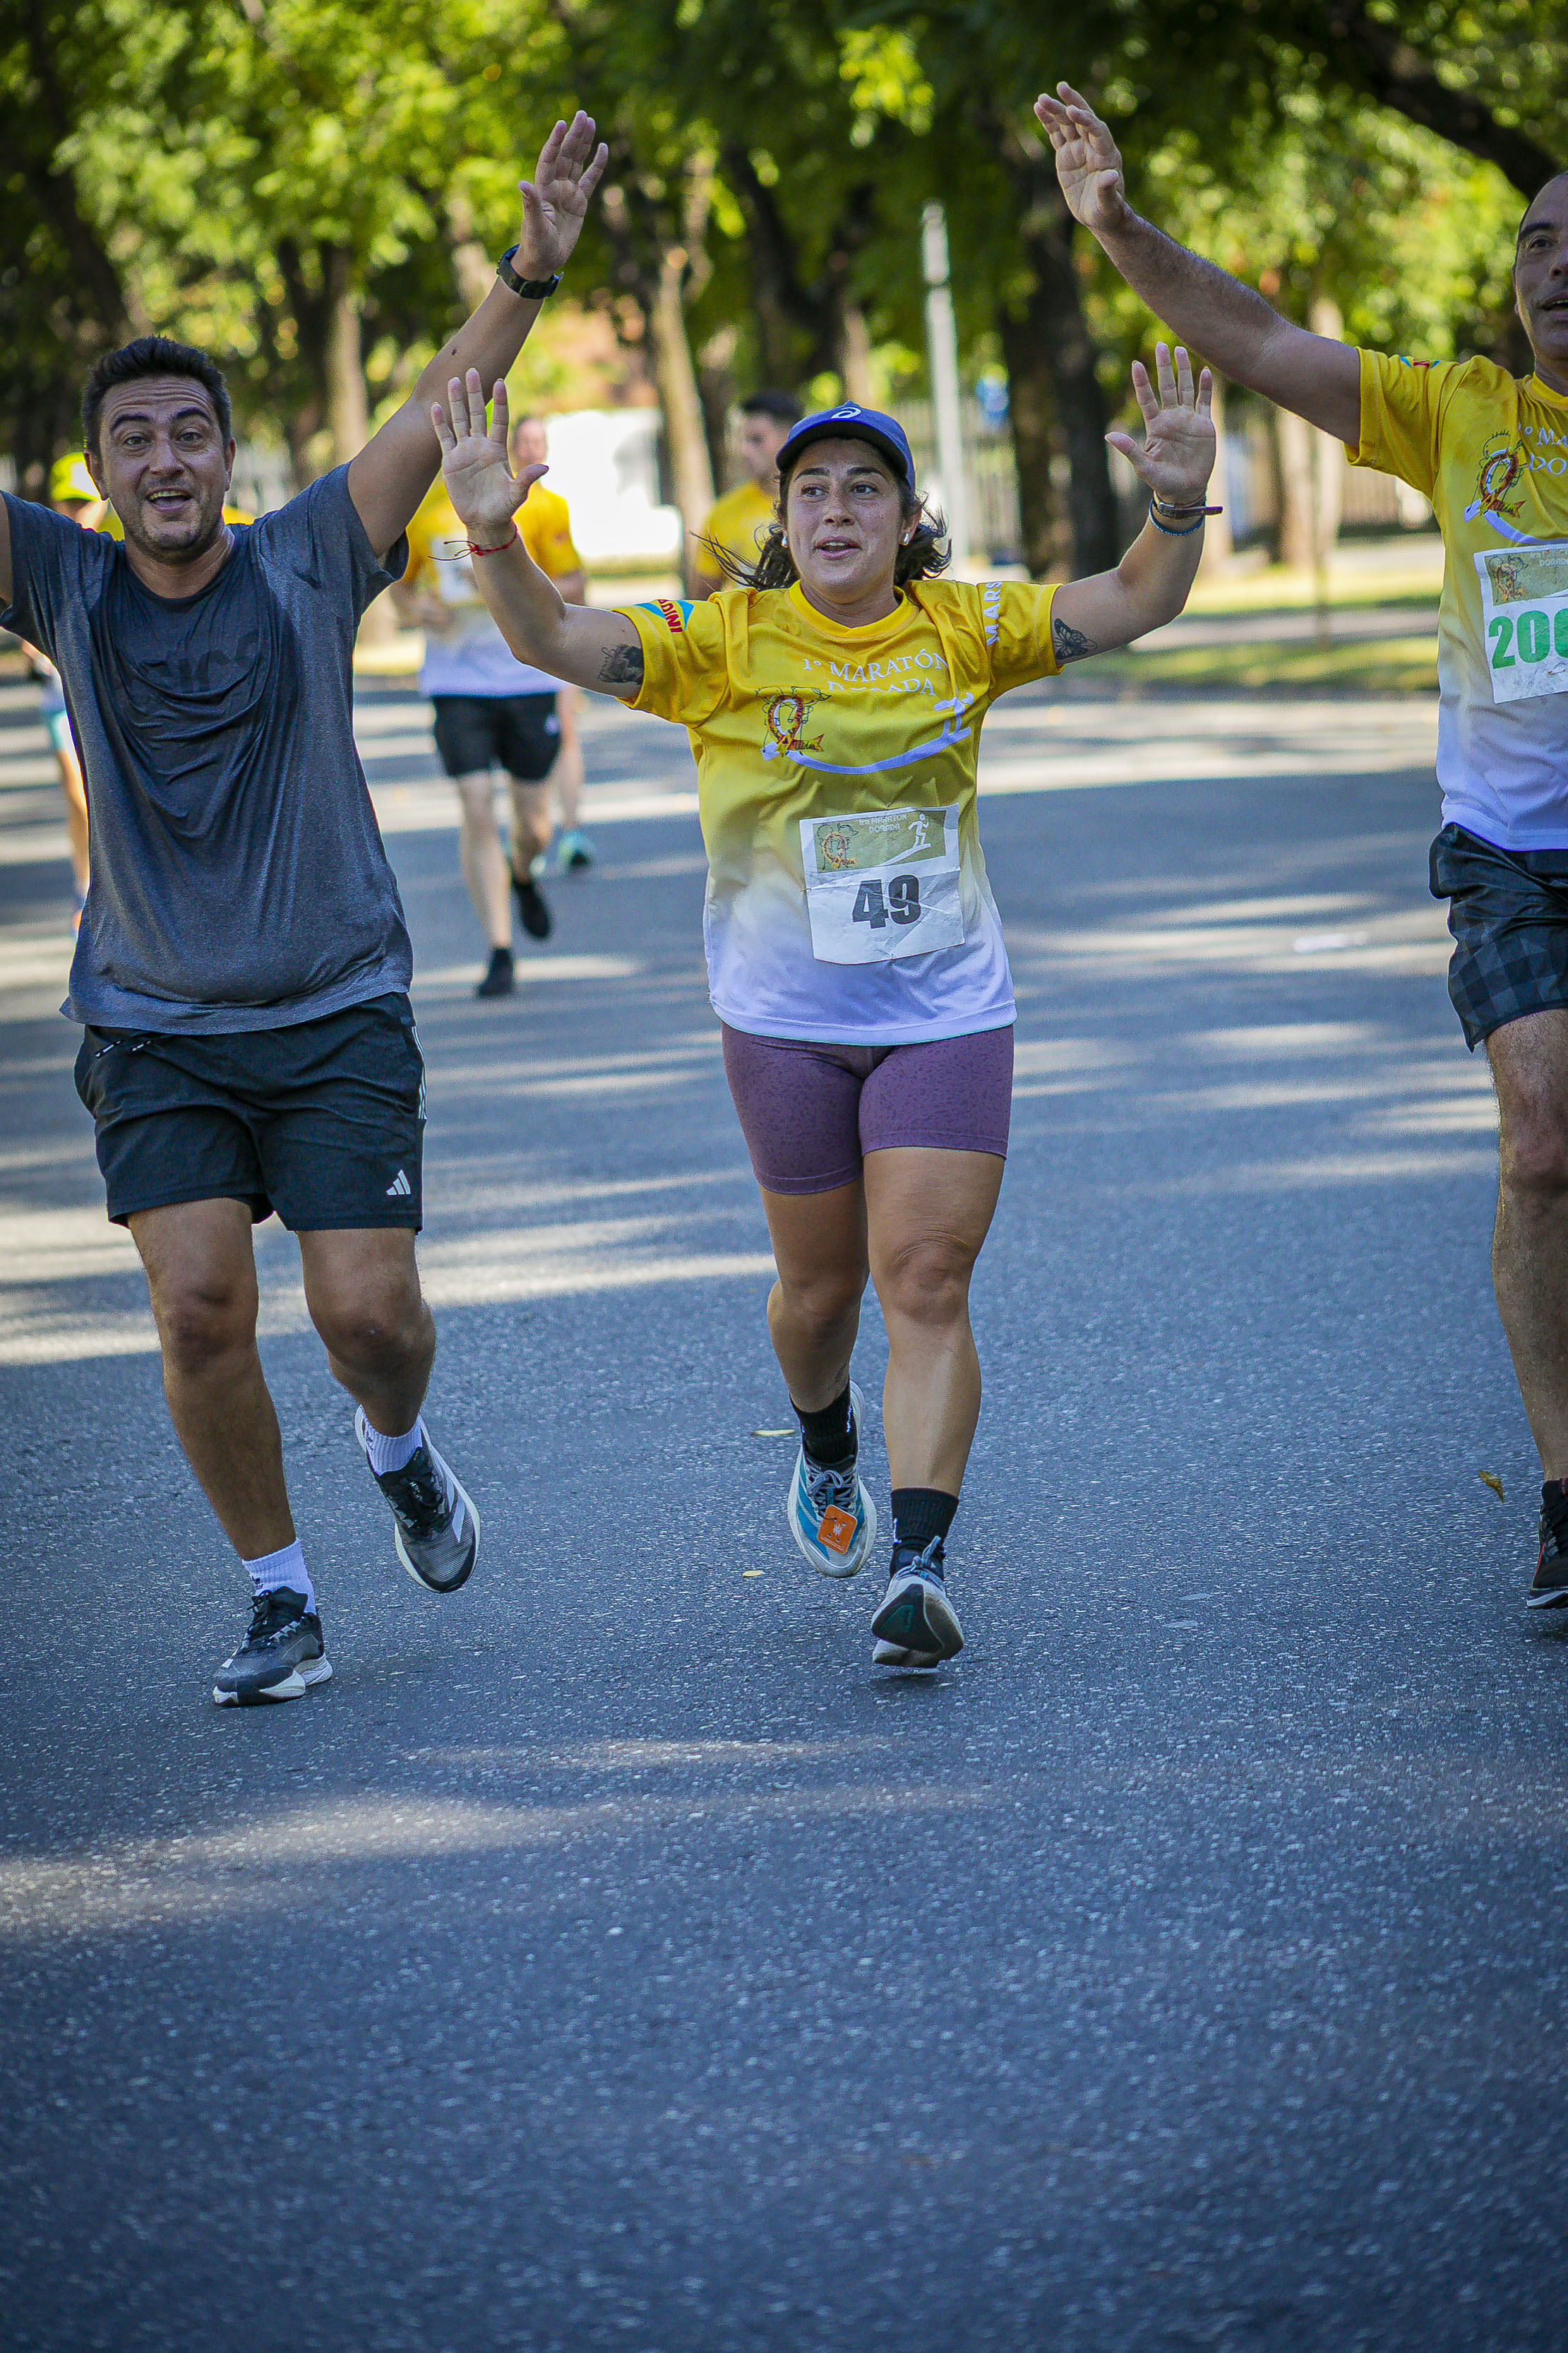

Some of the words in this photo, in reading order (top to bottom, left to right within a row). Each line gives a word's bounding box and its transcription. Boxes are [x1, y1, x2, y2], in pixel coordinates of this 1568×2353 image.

[829, 648, 950, 683] MARATÓN
[827, 677, 935, 696] DADA
[852, 874, 922, 929] 49
